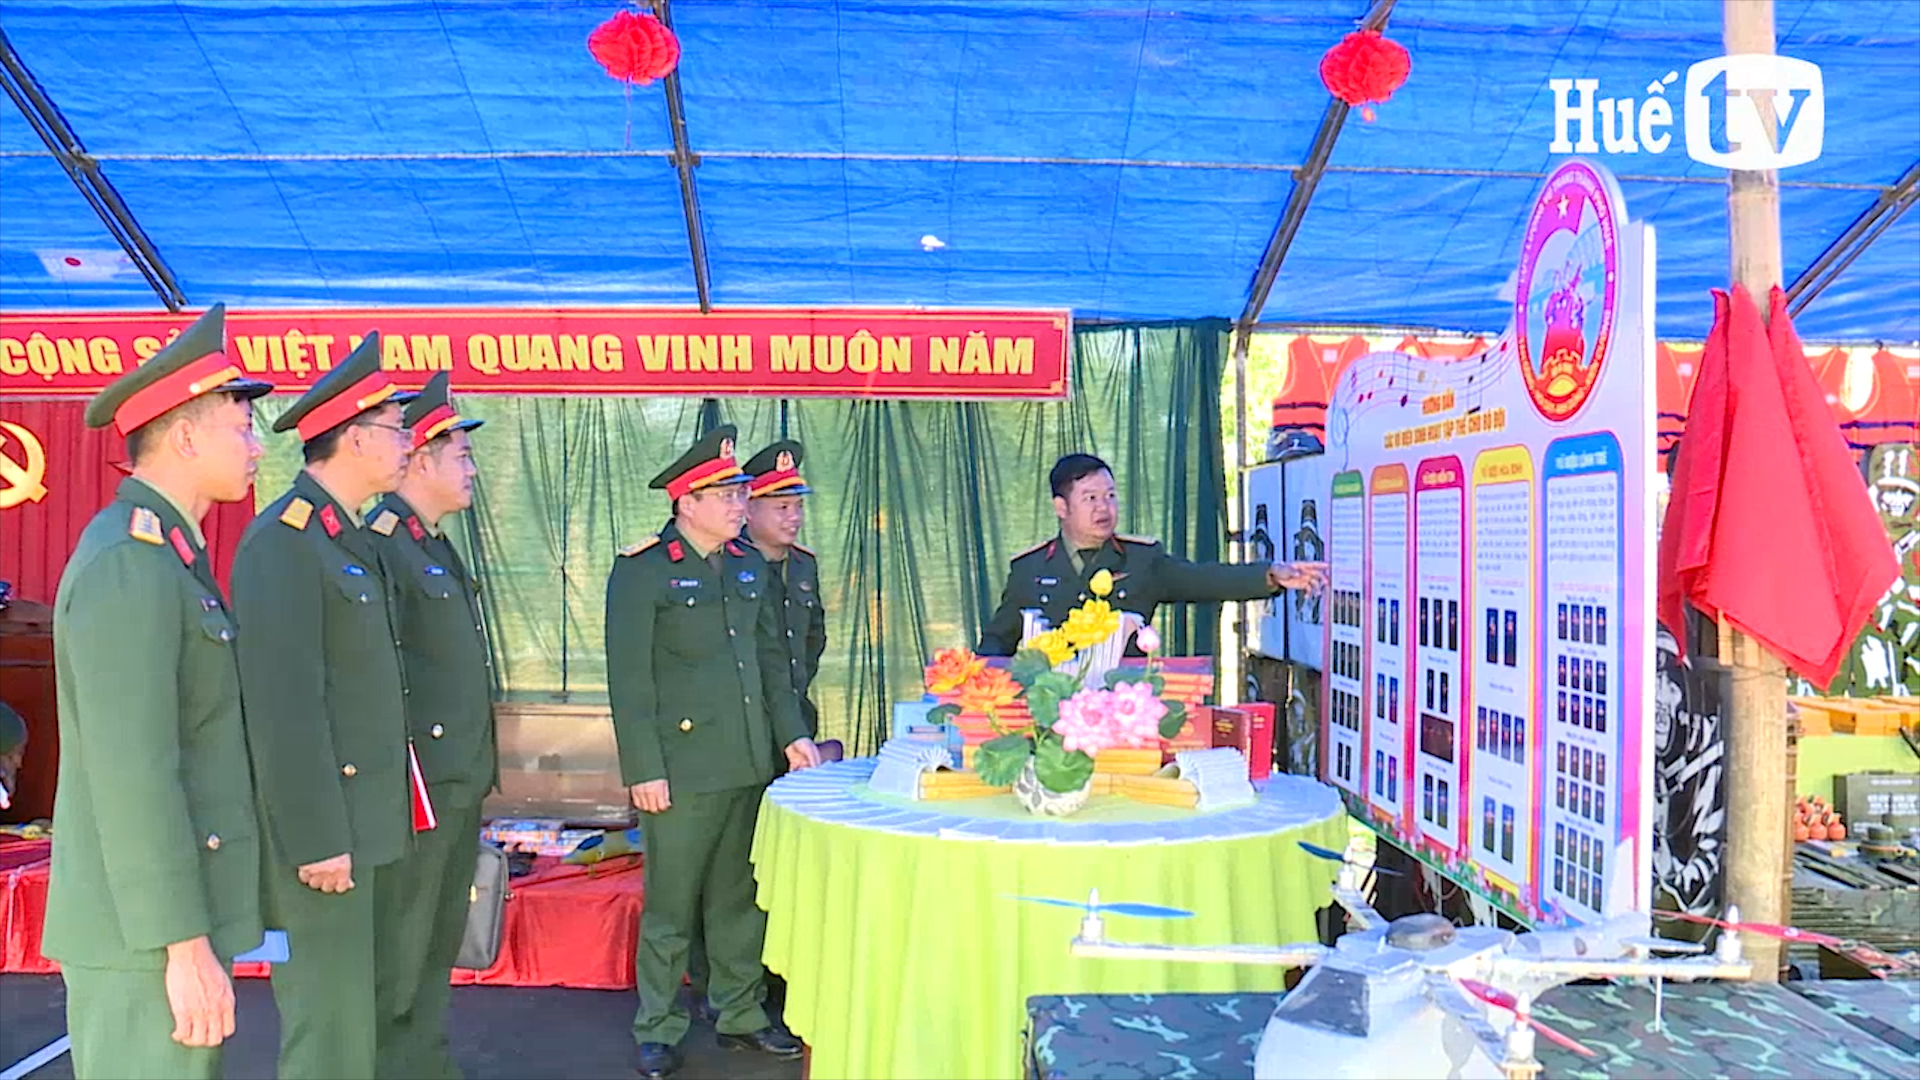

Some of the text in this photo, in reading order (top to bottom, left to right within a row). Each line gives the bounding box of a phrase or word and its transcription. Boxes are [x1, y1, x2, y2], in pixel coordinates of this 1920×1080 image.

[1, 331, 124, 382] CỘNG
[234, 329, 335, 379] VIỆT
[349, 335, 454, 371] AM
[466, 333, 624, 375] QUANG
[636, 334, 753, 372] VINH
[769, 329, 912, 374] MUÔN
[928, 330, 1036, 375] NĂM
